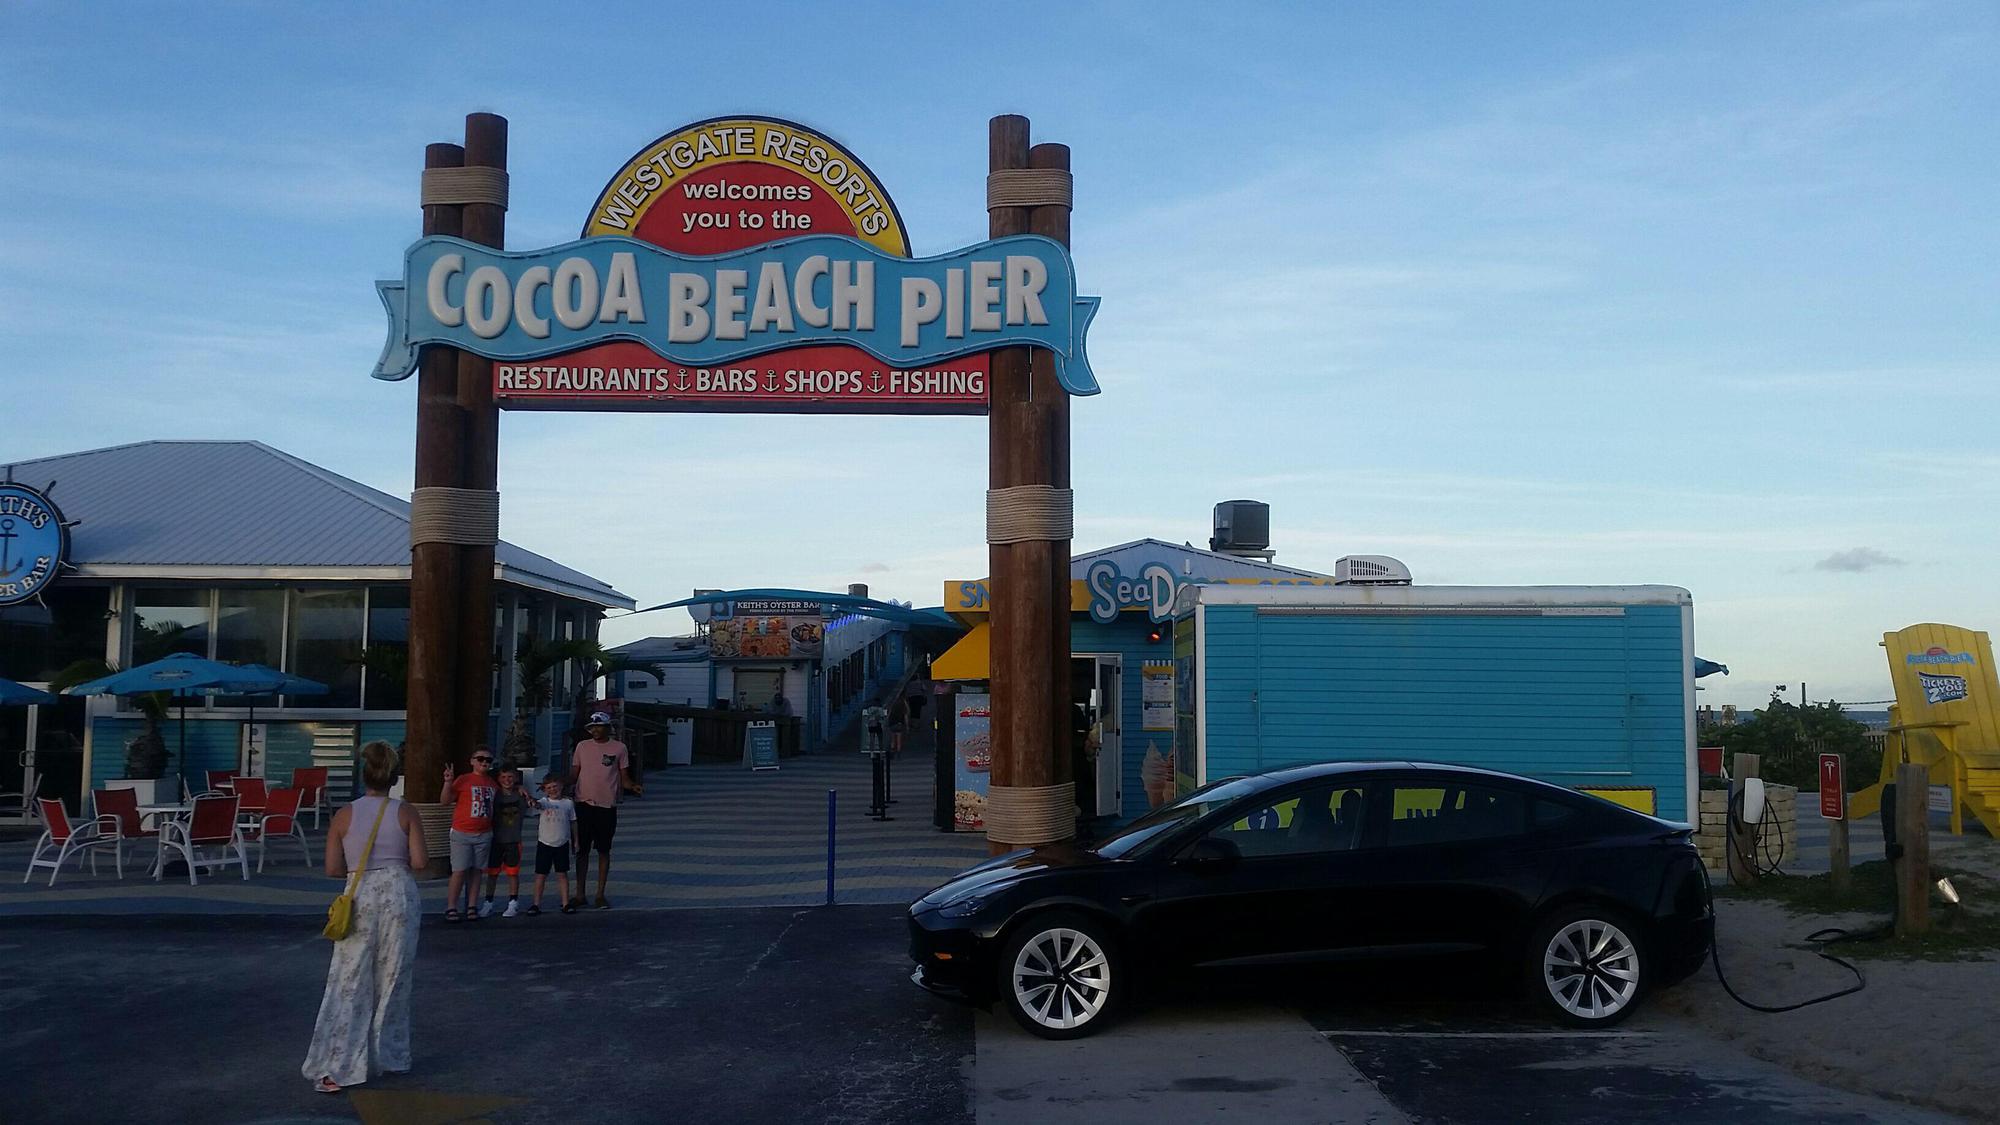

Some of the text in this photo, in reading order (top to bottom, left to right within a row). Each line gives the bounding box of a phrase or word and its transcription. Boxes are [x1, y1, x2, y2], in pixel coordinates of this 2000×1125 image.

[600, 128, 888, 235] WESTGATE RESORTS
[682, 179, 812, 200] welcomes
[682, 209, 812, 233] you to the
[427, 252, 1049, 347] COCOA BEACH PIER
[499, 366, 984, 394] RESTAURANTS BARS SHOPS FISHING
[20, 557, 50, 592] BAR
[737, 601, 820, 609] KEITH'S OYSTER BAR
[1921, 678, 1962, 688] TICKETS
[1928, 684, 1962, 703] 2 YOU
